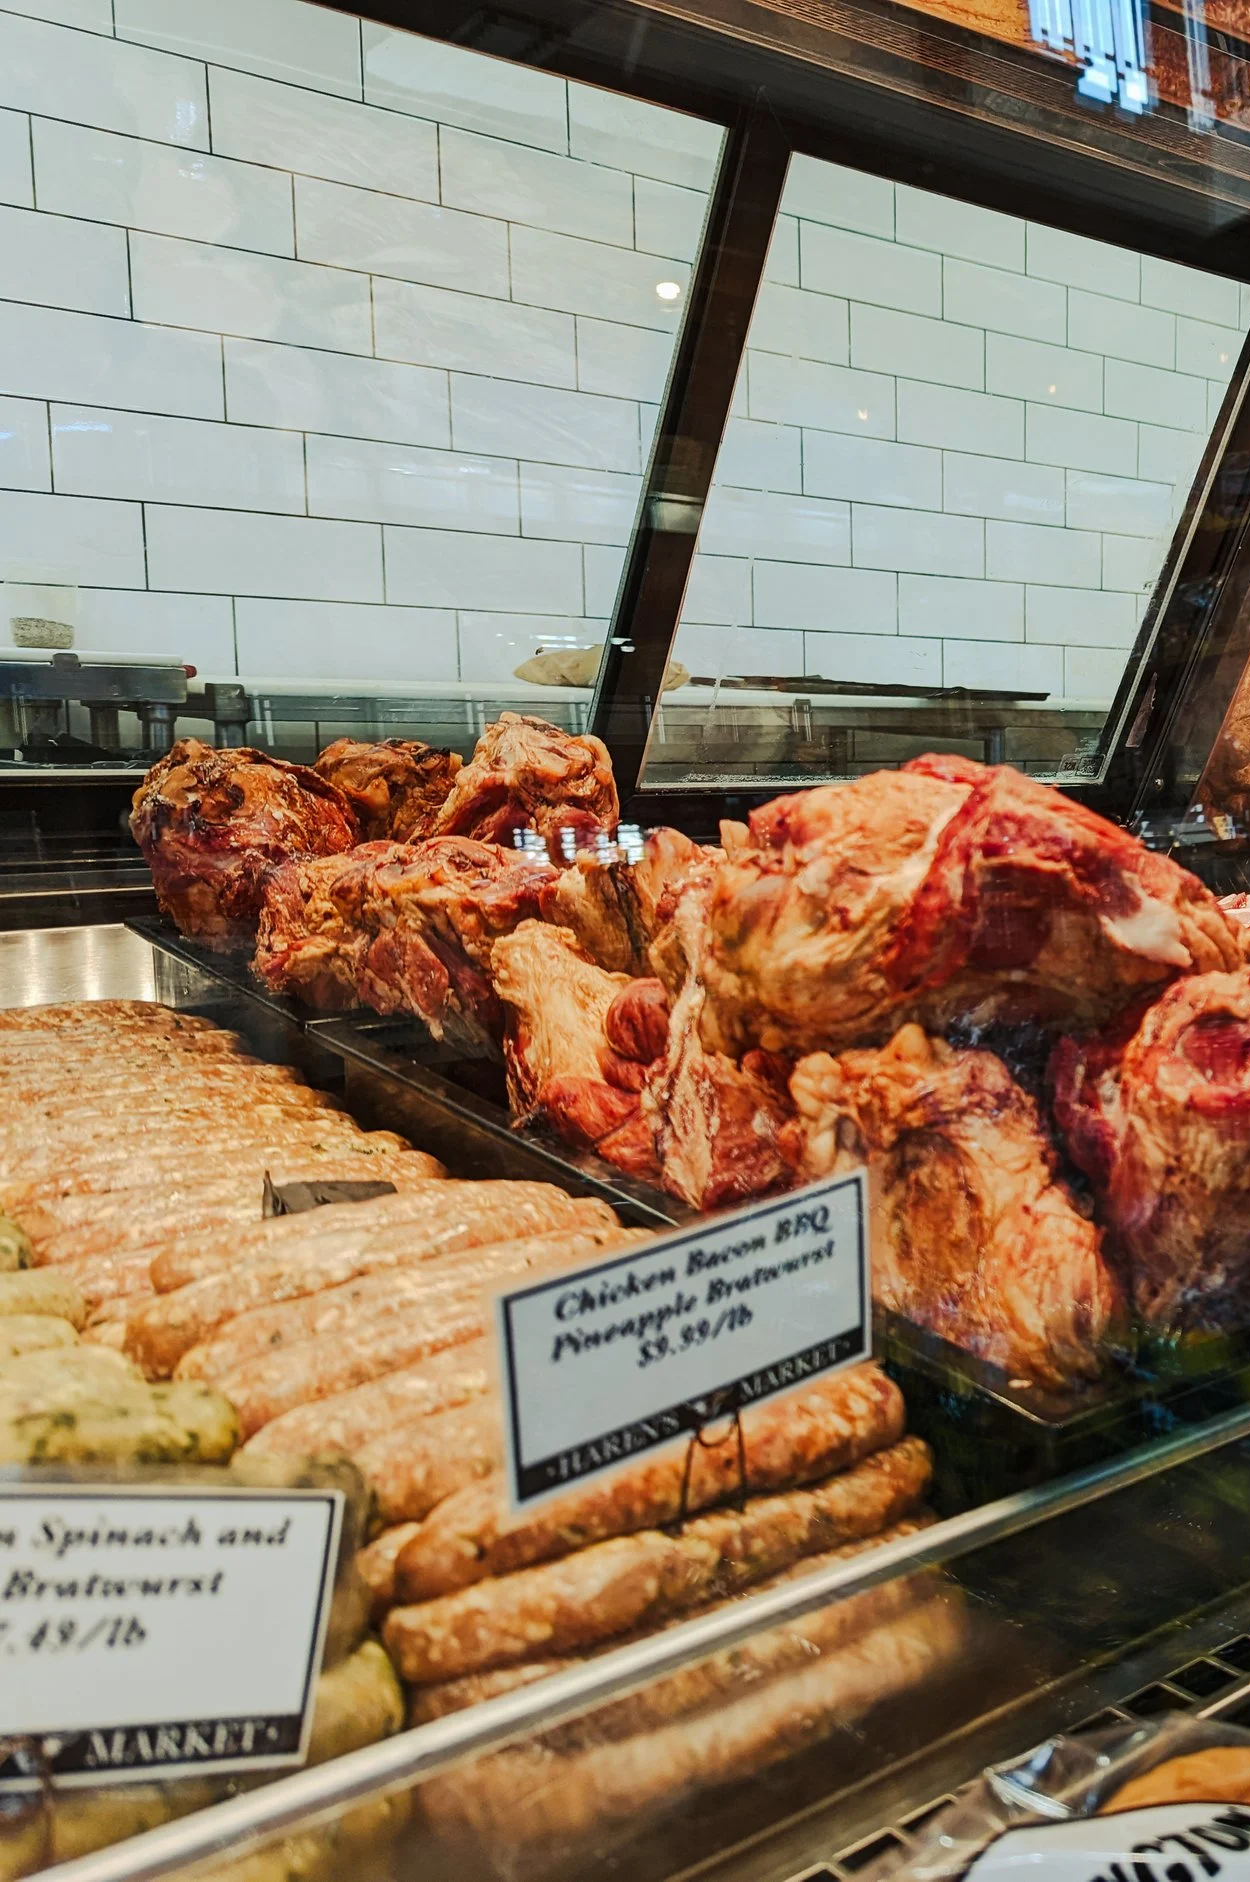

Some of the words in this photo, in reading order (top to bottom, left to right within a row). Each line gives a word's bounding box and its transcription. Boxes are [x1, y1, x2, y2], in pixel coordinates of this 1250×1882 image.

[553, 1266, 677, 1322] Chicken
[685, 1235, 767, 1277] Bacon
[773, 1204, 834, 1244] BBQ
[550, 1291, 698, 1364] Pineapple
[705, 1239, 835, 1306] Bratwurst
[738, 1342, 840, 1402] MARKET
[33, 1516, 204, 1558] Spinach
[217, 1518, 292, 1546] and
[3, 1570, 225, 1600] Bratwurst
[0, 1616, 147, 1652] .49/lb
[85, 1719, 266, 1768] MARKET
